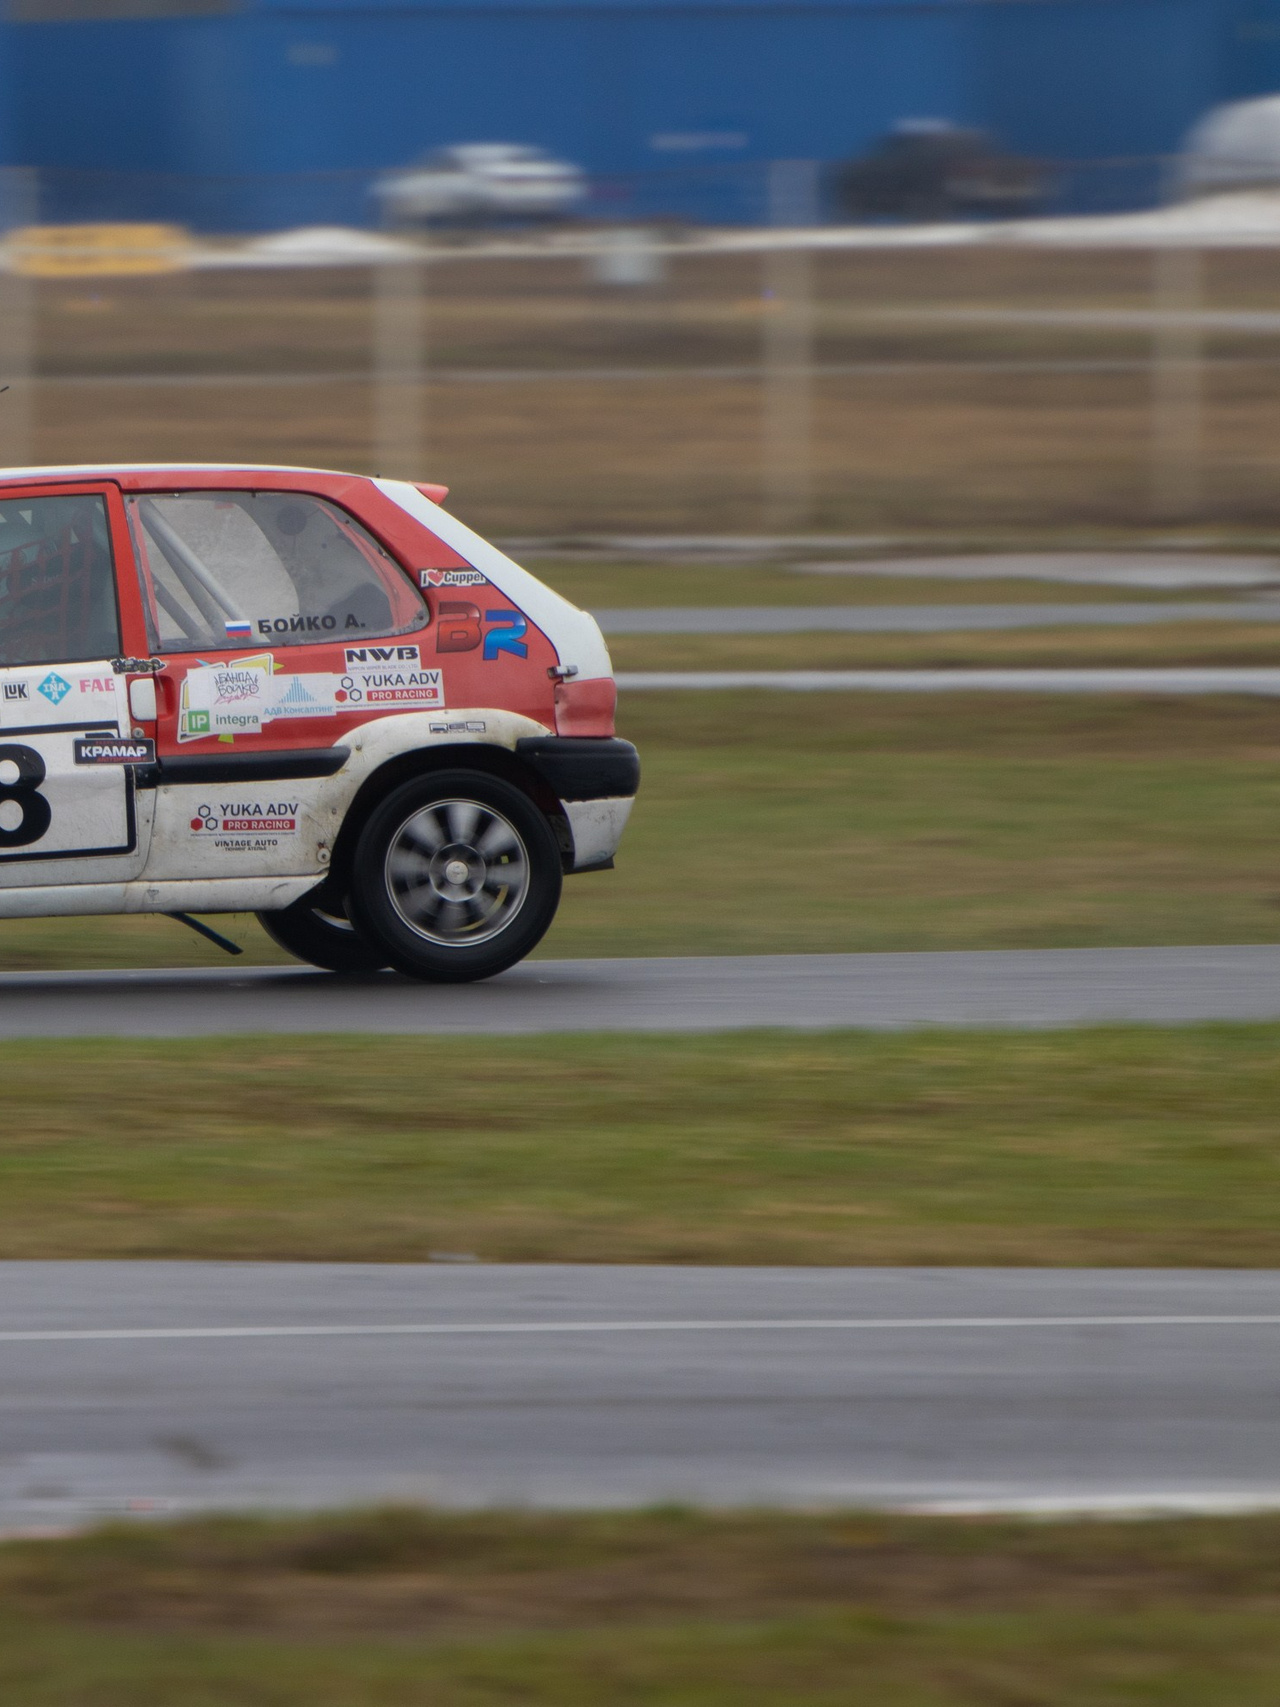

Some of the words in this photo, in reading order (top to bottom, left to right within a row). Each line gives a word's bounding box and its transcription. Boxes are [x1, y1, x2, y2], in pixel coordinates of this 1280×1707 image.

[257, 613, 337, 634] БОЙКО
[344, 613, 366, 628] А.
[346, 647, 419, 662] NWB
[362, 674, 405, 687] YUKA
[408, 672, 440, 685] ADV
[372, 691, 393, 700] PRO
[395, 689, 434, 699] RACING
[191, 714, 207, 729] IP
[215, 714, 259, 725] integra
[81, 746, 147, 758] КРАМАР
[220, 803, 263, 816] YUKA
[266, 803, 299, 816] ADV
[228, 820, 249, 830] PRO
[251, 820, 291, 829] RACING
